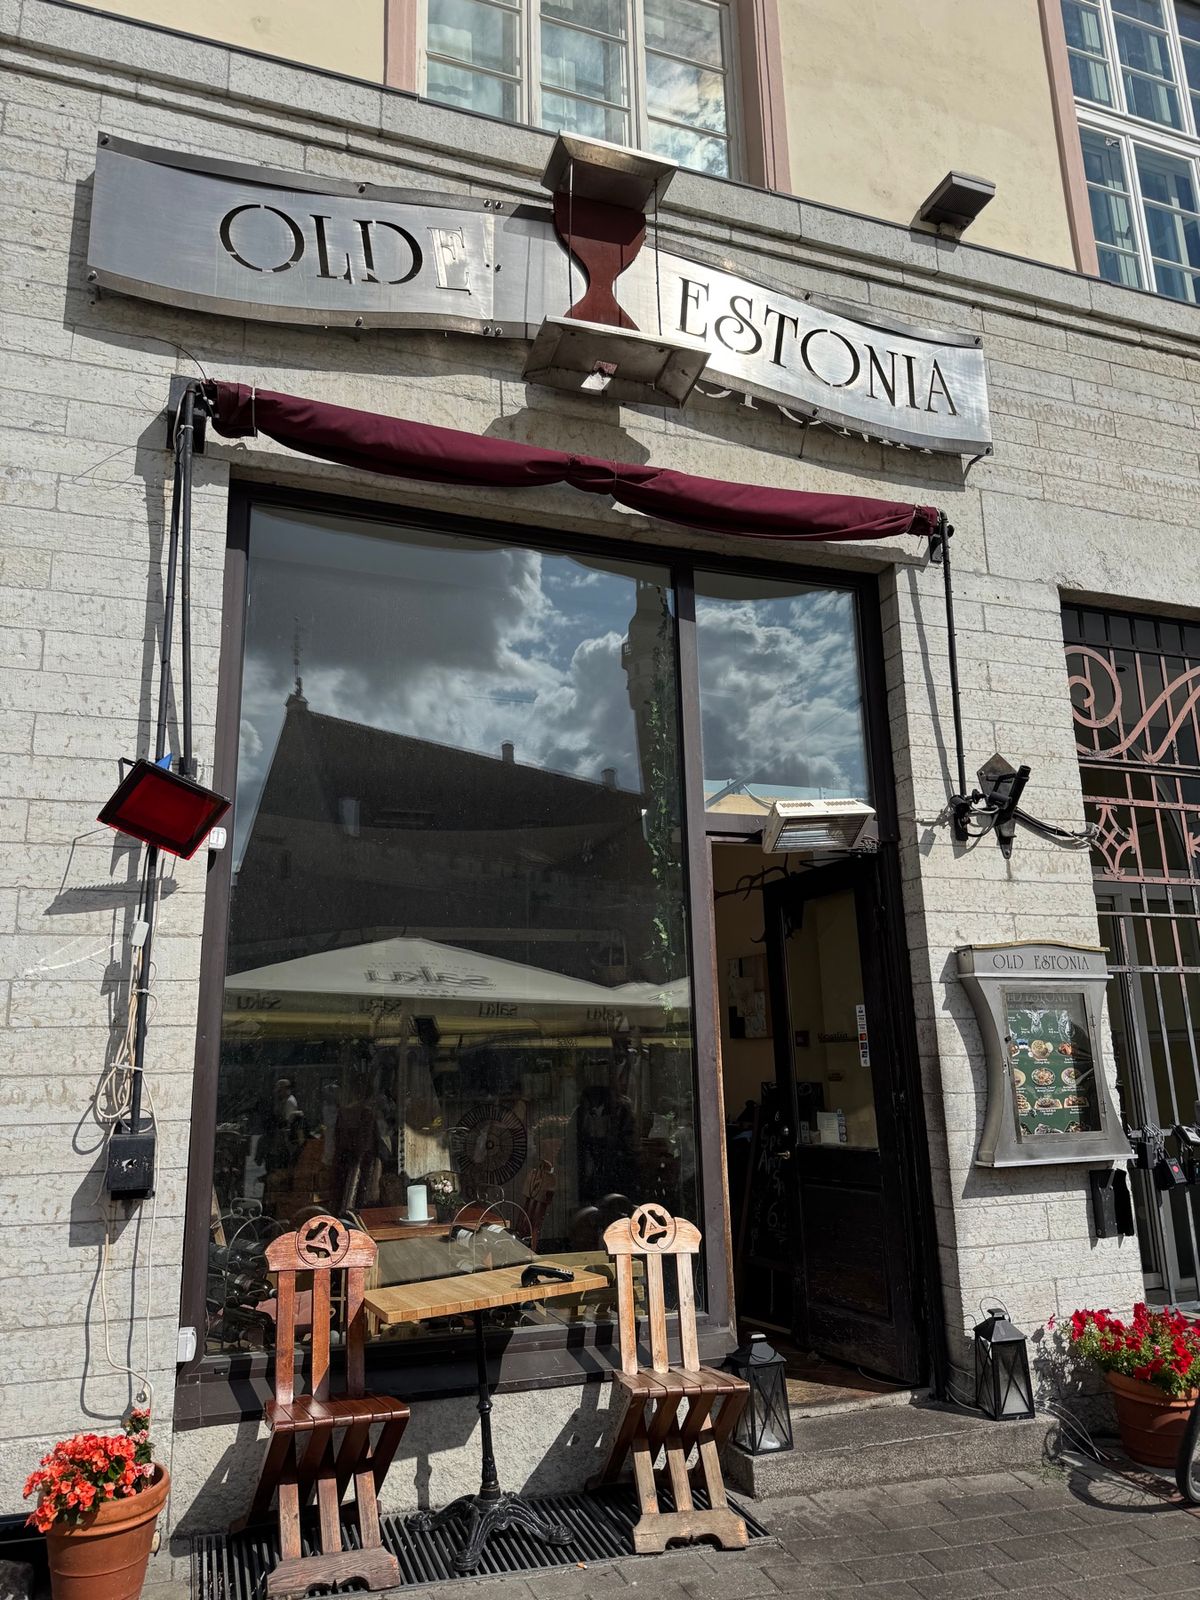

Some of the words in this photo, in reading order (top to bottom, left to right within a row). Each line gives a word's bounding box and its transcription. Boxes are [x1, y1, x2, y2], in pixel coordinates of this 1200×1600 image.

[675, 275, 962, 417] ESTONIA
[992, 954, 1024, 970] OLD
[1034, 955, 1090, 970] ESTONIA
